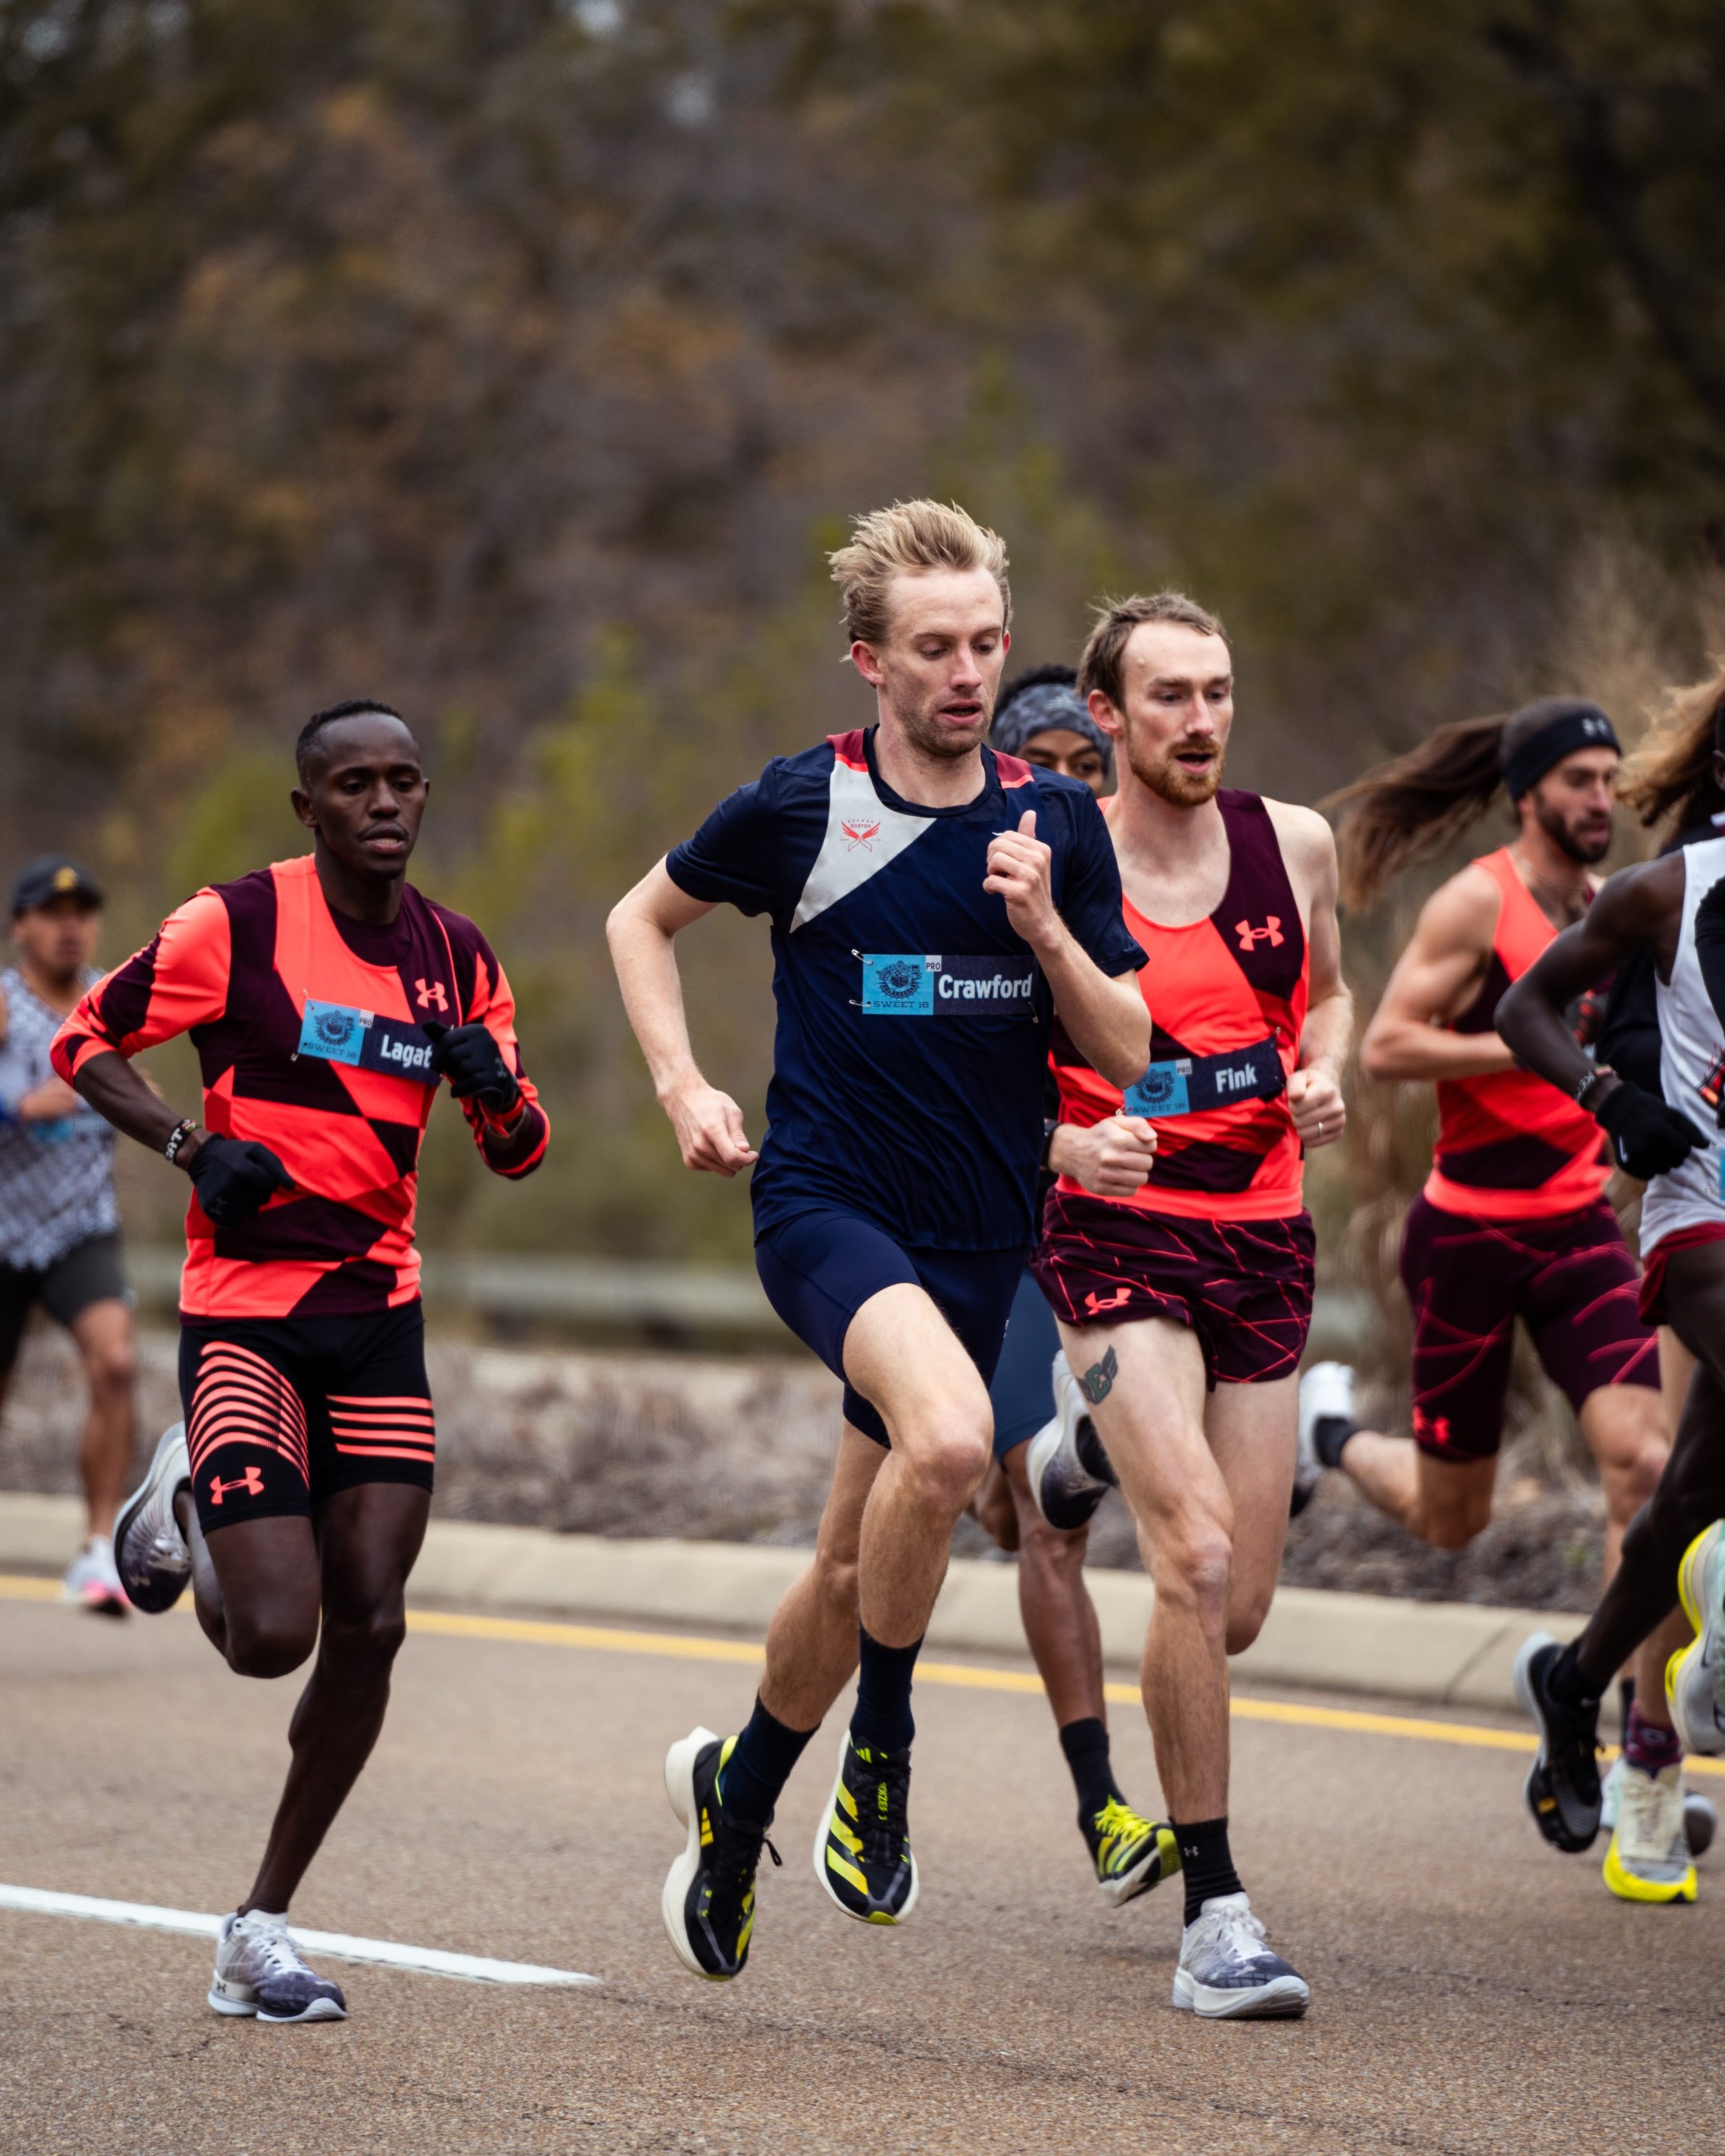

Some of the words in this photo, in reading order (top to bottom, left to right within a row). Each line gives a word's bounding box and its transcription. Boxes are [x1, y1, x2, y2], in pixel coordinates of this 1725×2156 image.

[925, 962, 940, 971] PRO
[938, 973, 1033, 999] Crawford
[359, 1017, 373, 1026] PRO
[381, 1034, 433, 1069] Lagat
[1176, 1066, 1191, 1074] PRO
[1215, 1062, 1258, 1094] Fink
